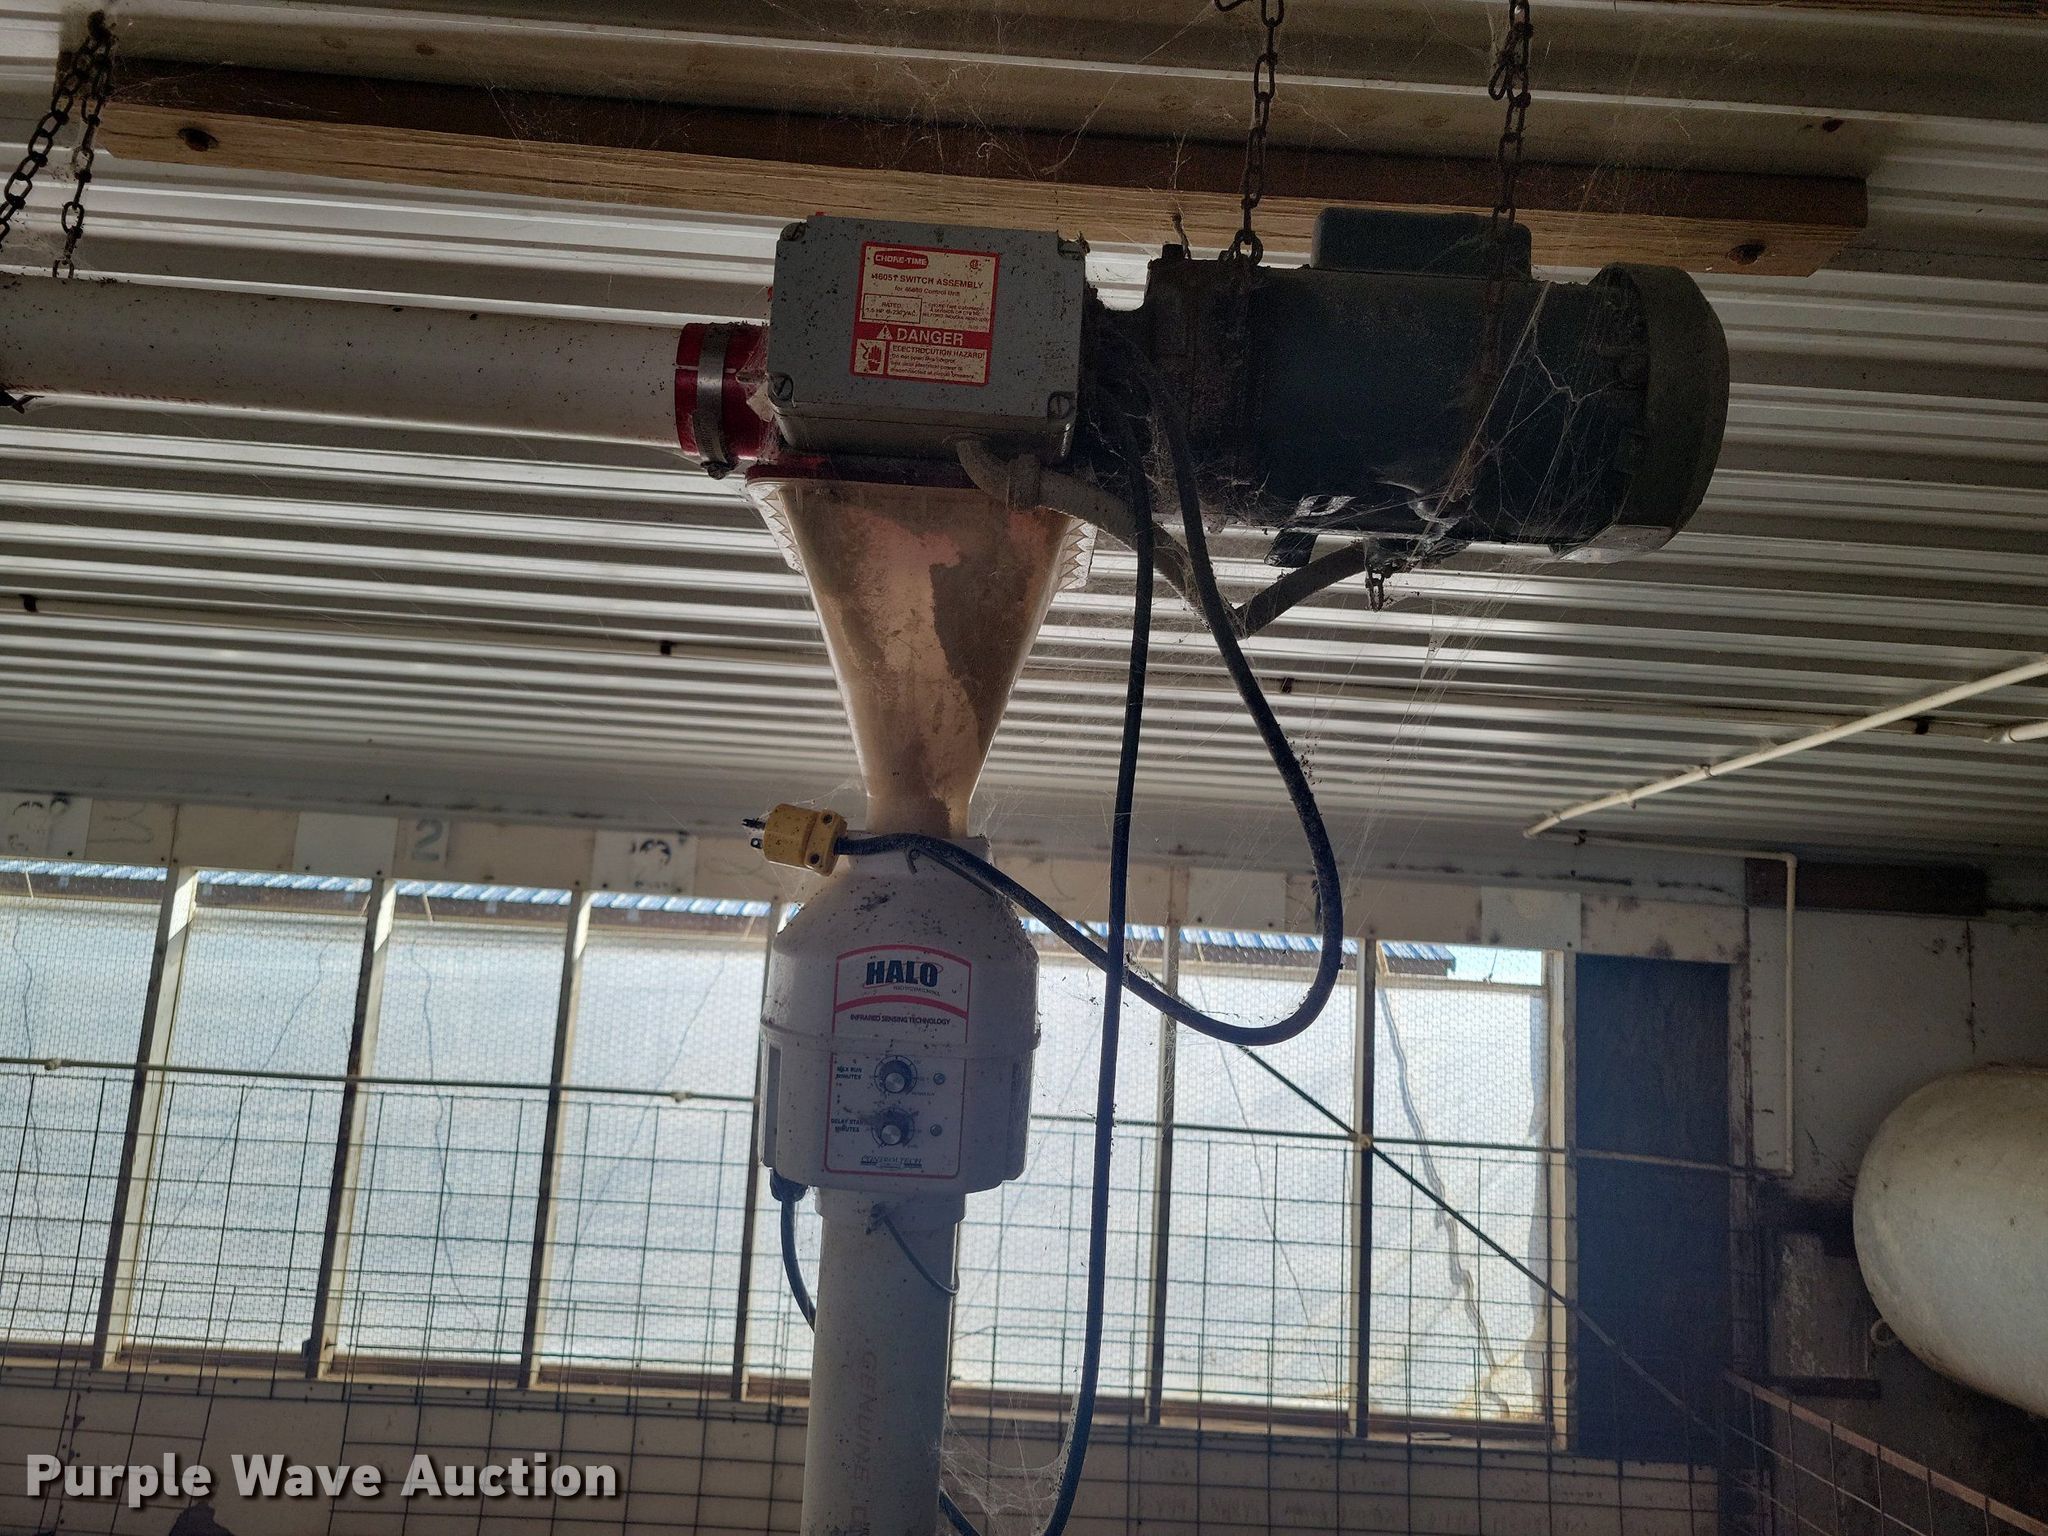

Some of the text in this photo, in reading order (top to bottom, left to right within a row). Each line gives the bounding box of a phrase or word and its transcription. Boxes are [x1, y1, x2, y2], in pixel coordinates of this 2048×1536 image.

[875, 254, 928, 266] CHORE-TIME
[900, 275, 934, 285] SWITCH
[936, 278, 984, 289] ASSEMBLY
[896, 327, 964, 347] DANGER
[892, 344, 952, 356] ELECTROCUTION
[953, 350, 985, 360] HAZARD!
[411, 817, 442, 861] 2
[865, 960, 938, 987] HALO
[850, 1013, 951, 1025] INFRARED SENSING TECHNOLOGY
